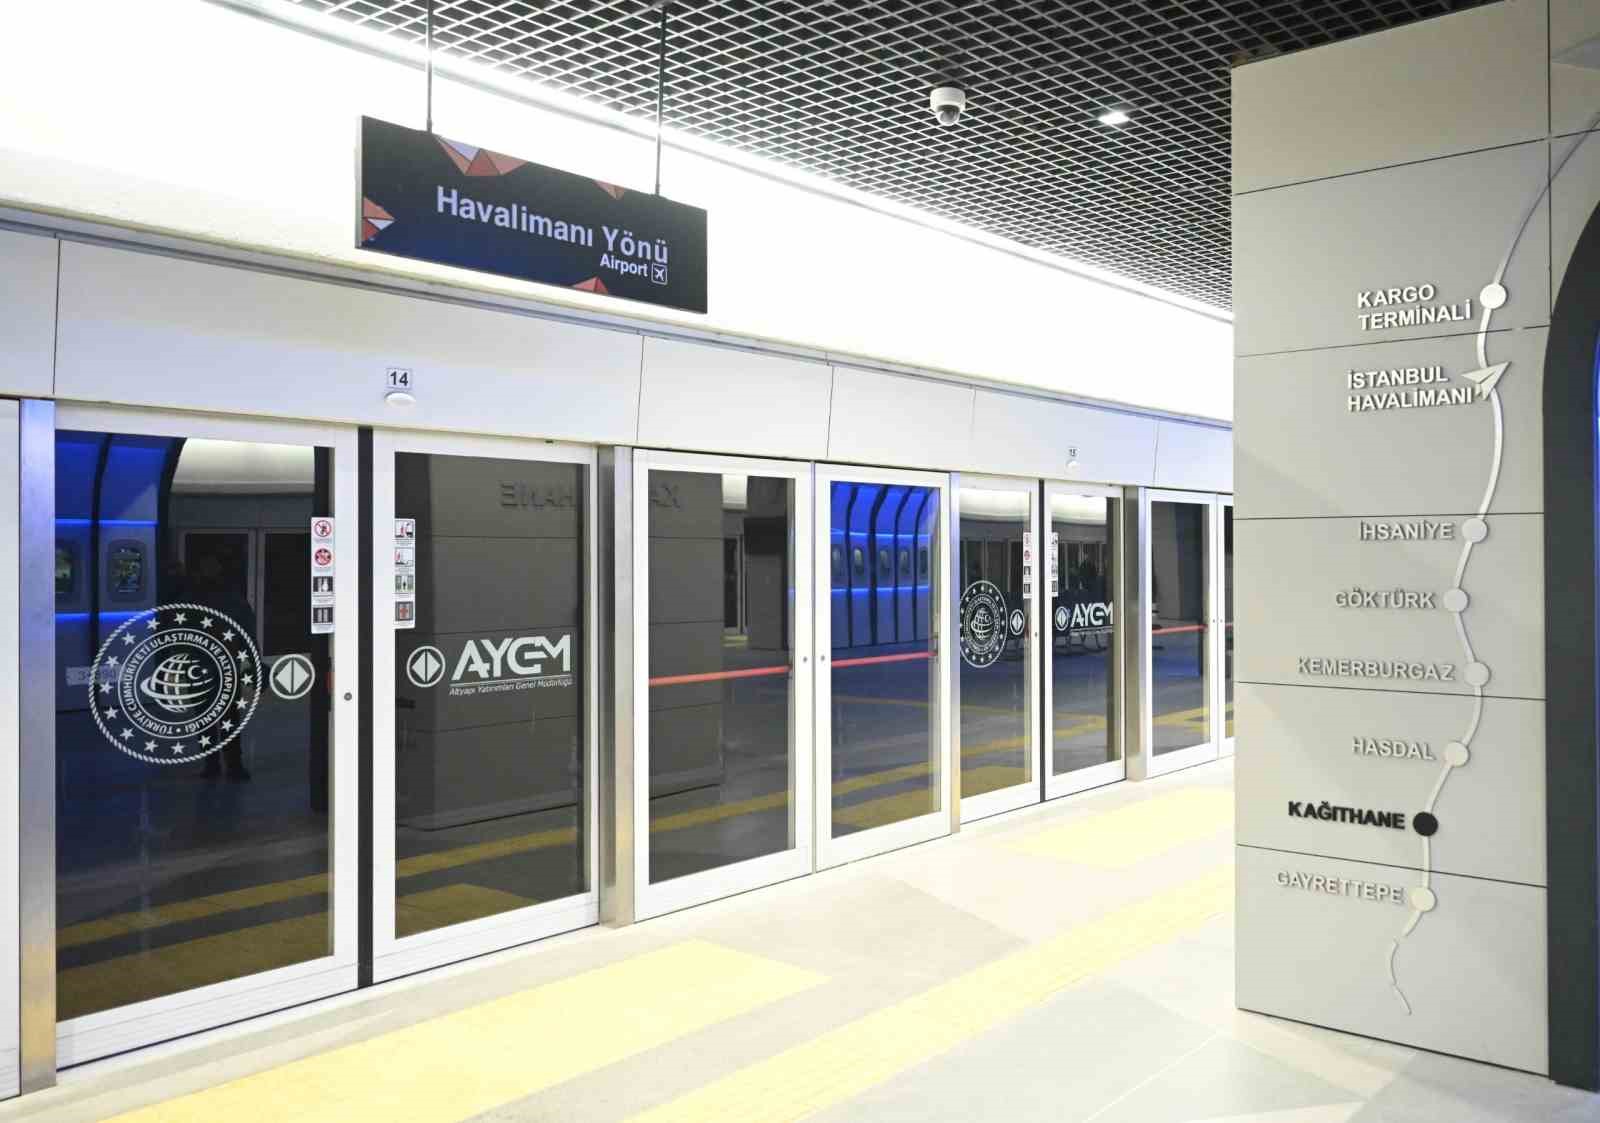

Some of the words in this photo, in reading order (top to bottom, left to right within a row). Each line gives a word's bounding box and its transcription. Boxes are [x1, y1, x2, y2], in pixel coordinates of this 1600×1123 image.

[437, 185, 593, 247] Havalimanı
[601, 225, 668, 264] Yönü
[600, 253, 648, 278] Airport
[1357, 284, 1435, 309] KARGO
[1358, 298, 1472, 331] TERMİNALİ
[390, 371, 408, 386] 14
[1347, 366, 1449, 389] İSTANBUL
[1347, 387, 1473, 411] HAVALİMANI
[1360, 520, 1455, 541] İHSANİYE
[1335, 586, 1436, 609] GÖKTÜRK
[451, 634, 571, 680] AYGM
[1297, 656, 1456, 681] KEMERBURGAZ
[1352, 737, 1436, 760] HASDAL
[1288, 801, 1406, 830] KAĞITHANE
[1277, 871, 1405, 904] GAYRETTEPE
